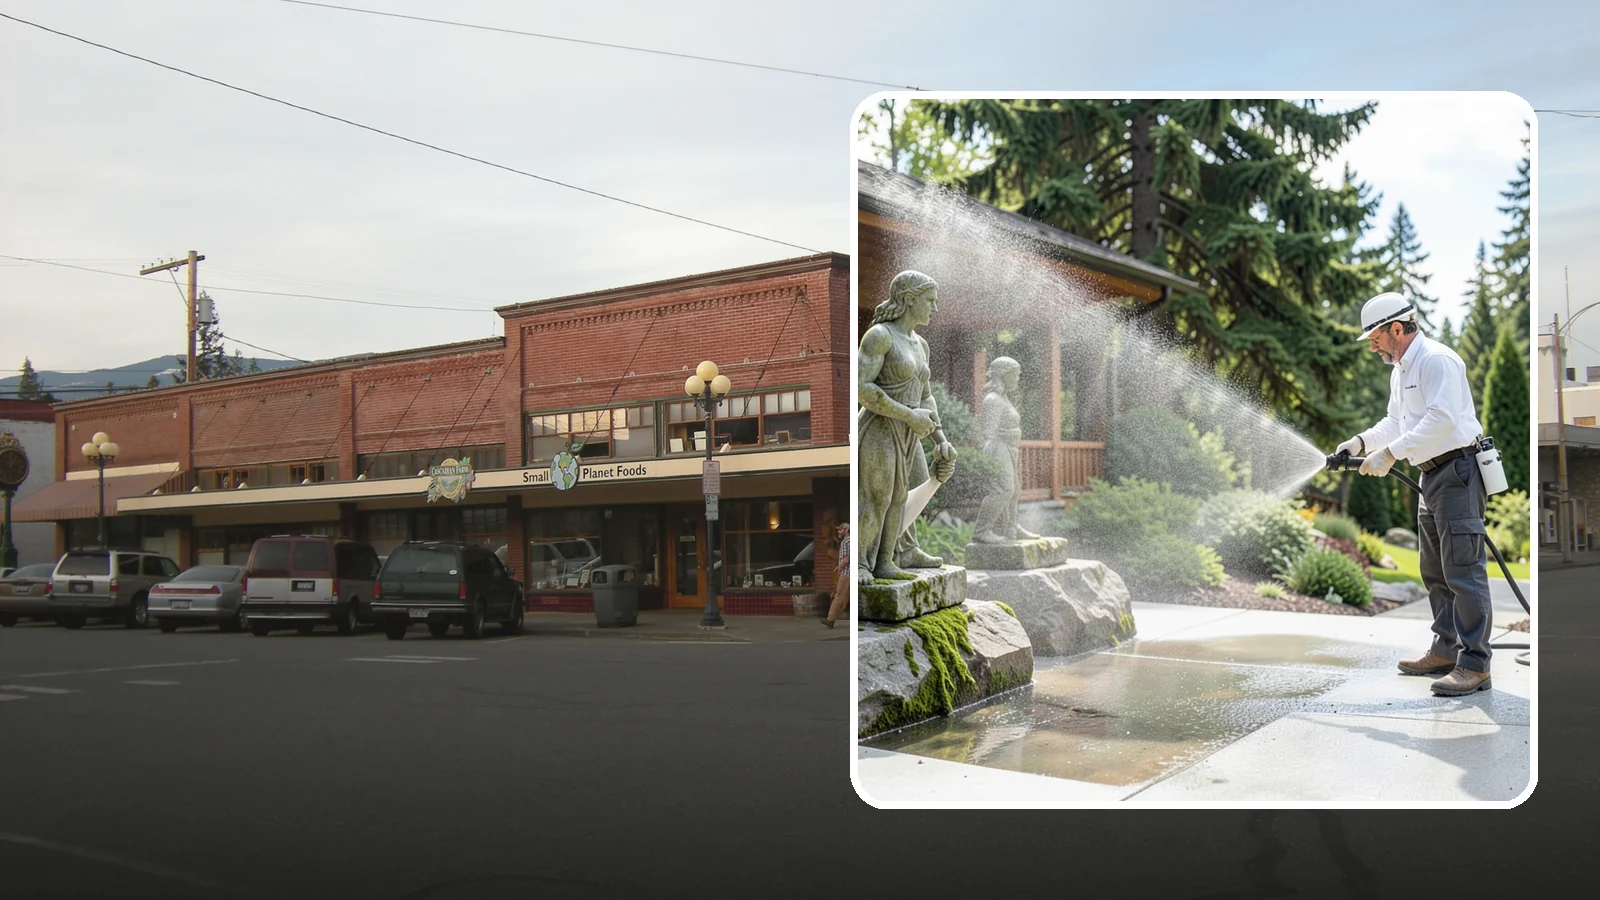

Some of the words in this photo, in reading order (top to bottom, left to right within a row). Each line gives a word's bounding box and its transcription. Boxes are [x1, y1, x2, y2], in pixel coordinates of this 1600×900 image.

[523, 471, 549, 482] Small
[583, 467, 613, 479] Planet
[617, 465, 647, 476] Foods
